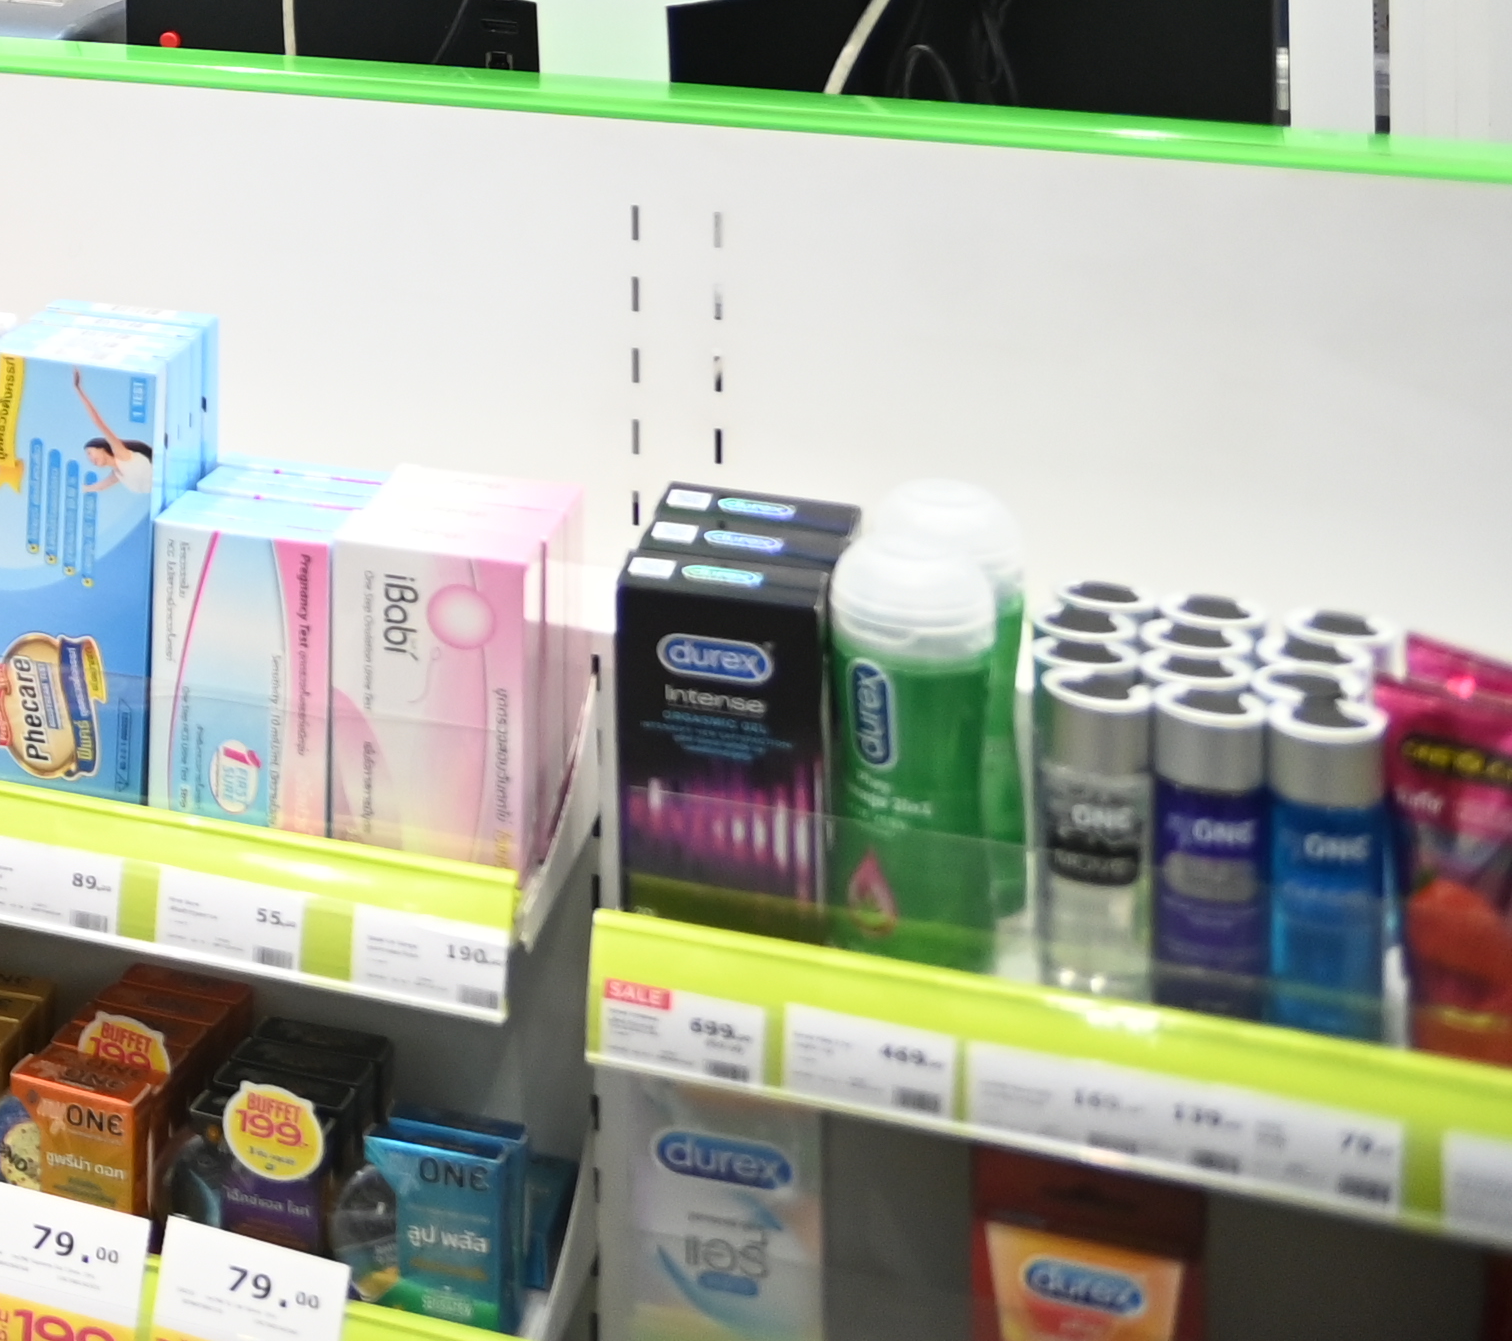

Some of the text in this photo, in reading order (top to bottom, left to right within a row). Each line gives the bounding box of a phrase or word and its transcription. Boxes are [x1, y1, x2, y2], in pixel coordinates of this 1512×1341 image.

[664, 639, 763, 677] durex
[9, 655, 52, 764] Phecare
[664, 684, 767, 716] Intense
[604, 979, 664, 1008] SALE
